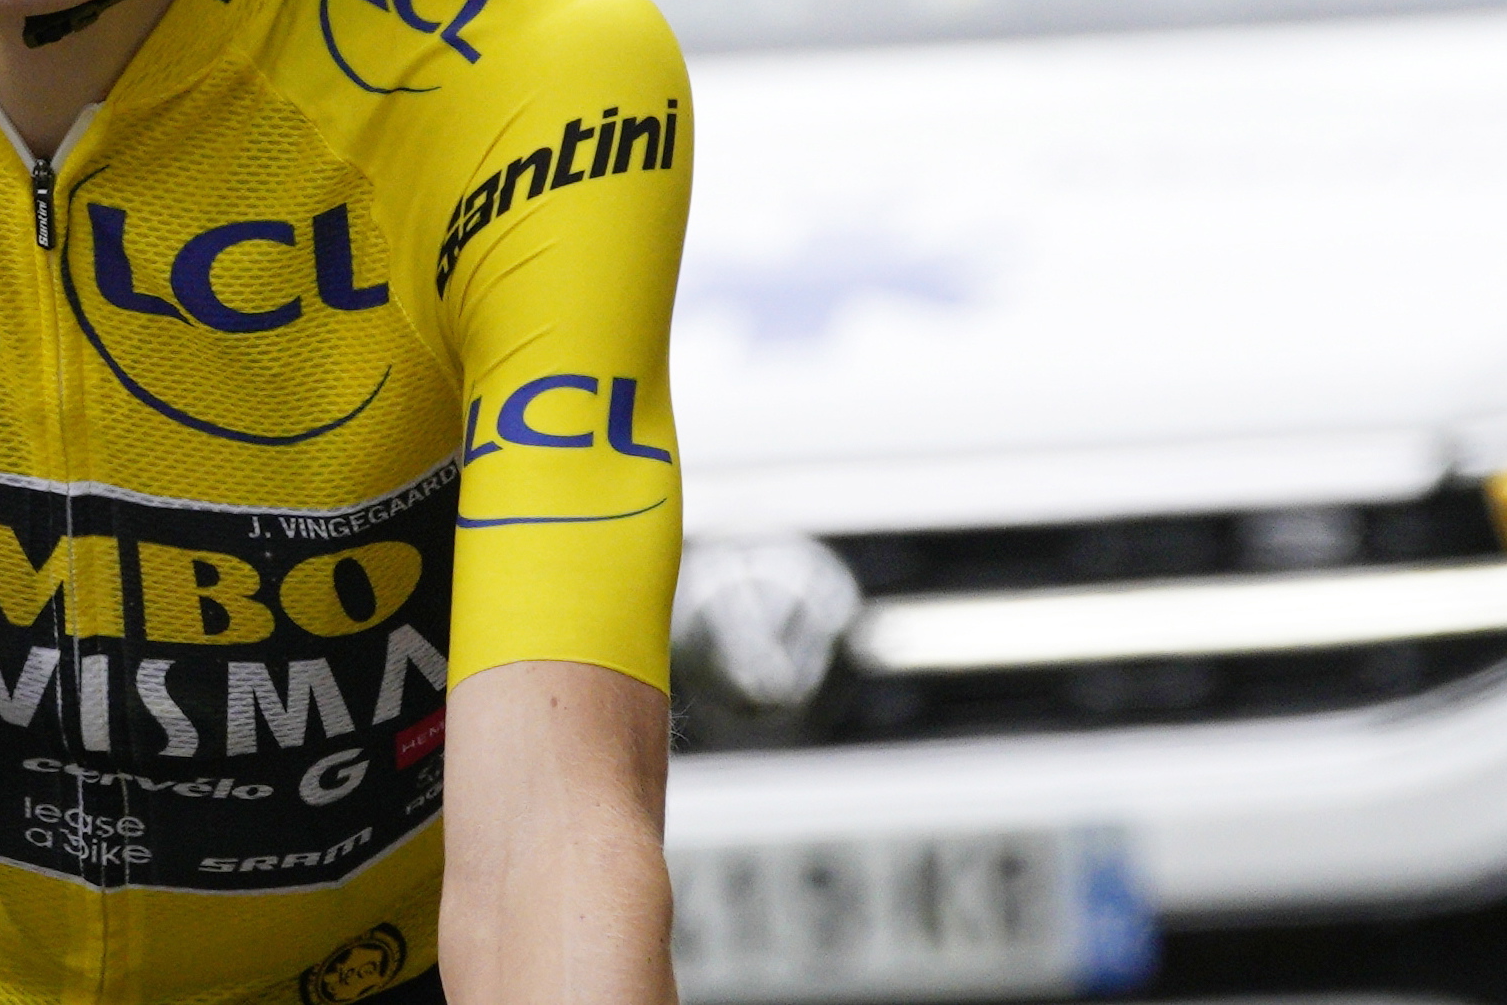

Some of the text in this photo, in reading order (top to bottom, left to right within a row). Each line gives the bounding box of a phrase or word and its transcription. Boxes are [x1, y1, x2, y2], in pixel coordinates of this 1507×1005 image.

[37, 199, 49, 246] Santini
[87, 202, 390, 333] LCL
[463, 374, 673, 466] LCL
[248, 465, 459, 540] J. VINGEGAARD
[24, 796, 146, 838] lease
[25, 827, 53, 848] a
[197, 826, 373, 873] SRAM
